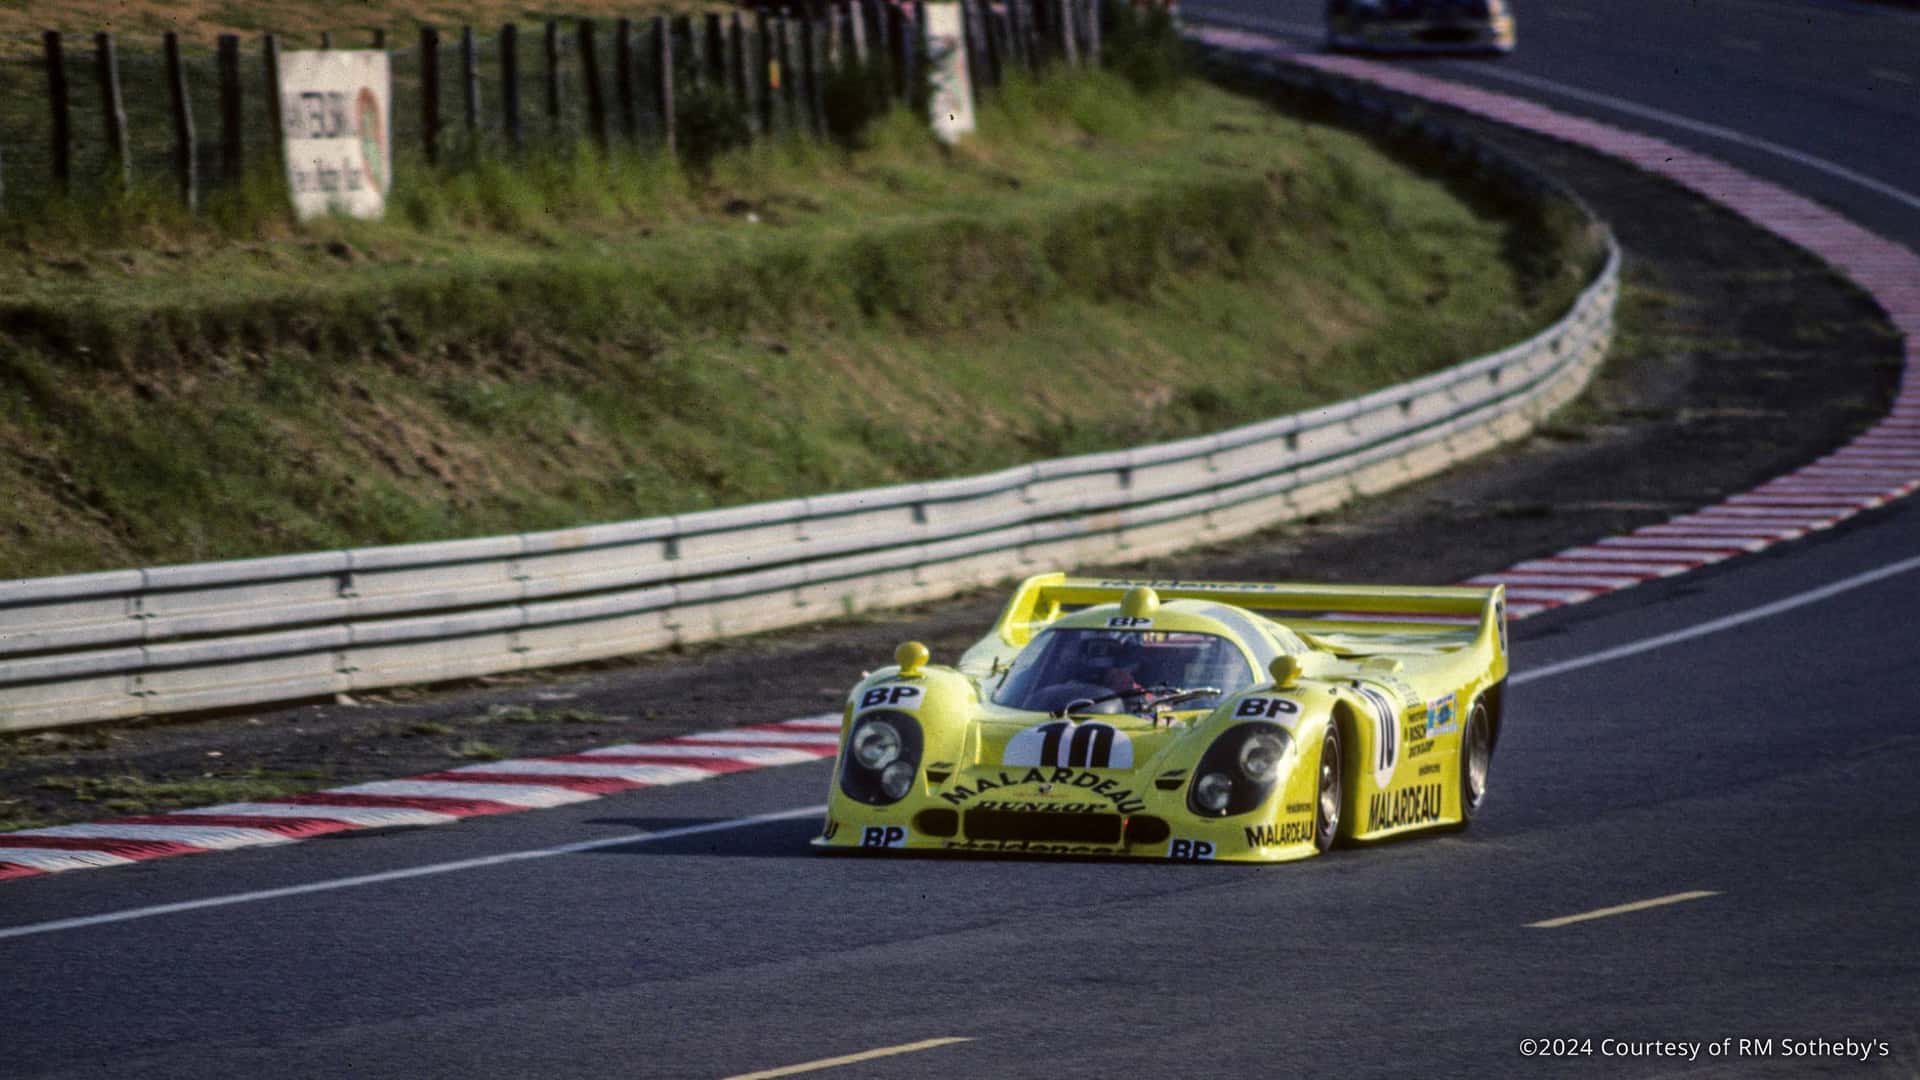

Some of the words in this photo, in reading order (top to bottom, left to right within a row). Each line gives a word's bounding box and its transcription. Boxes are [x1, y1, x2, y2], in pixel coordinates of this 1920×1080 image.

[1108, 617, 1151, 627] BP
[860, 686, 919, 708] BP
[1236, 698, 1298, 718] BP
[1353, 687, 1395, 771] 10
[1036, 721, 1115, 768] 10
[941, 767, 1145, 814] MALARDEAU
[976, 801, 1108, 813] DUNLOP
[1367, 783, 1441, 833] MALARDEAU
[862, 826, 904, 848] BP
[1245, 820, 1313, 848] MALARDEAU
[1170, 838, 1213, 859] BP
